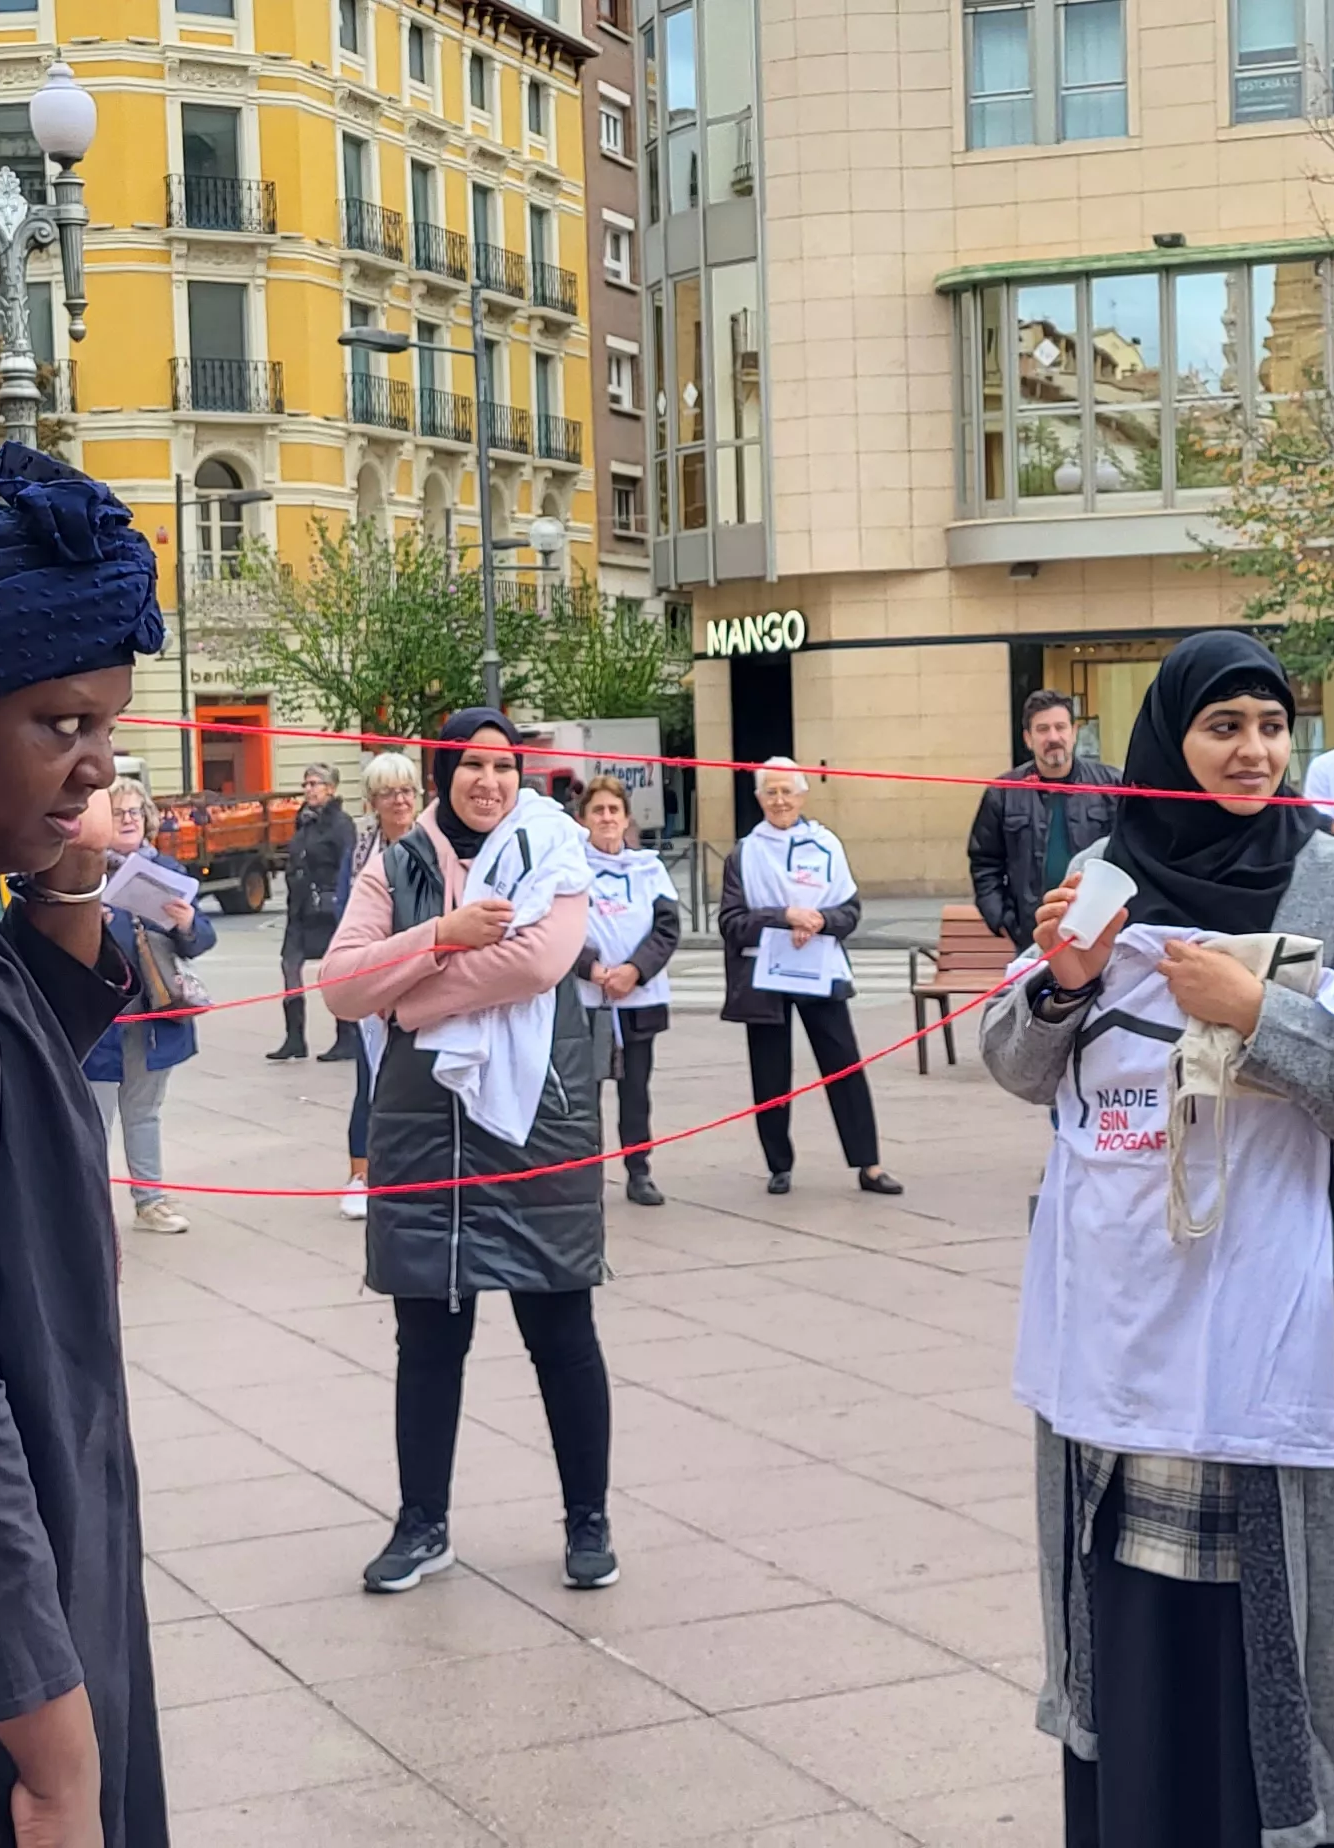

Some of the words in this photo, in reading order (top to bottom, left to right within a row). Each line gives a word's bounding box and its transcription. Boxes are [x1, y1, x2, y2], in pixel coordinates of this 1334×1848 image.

[707, 610, 805, 656] MANGO
[1097, 1089, 1159, 1108] NADIE
[1099, 1110, 1129, 1131] SIN
